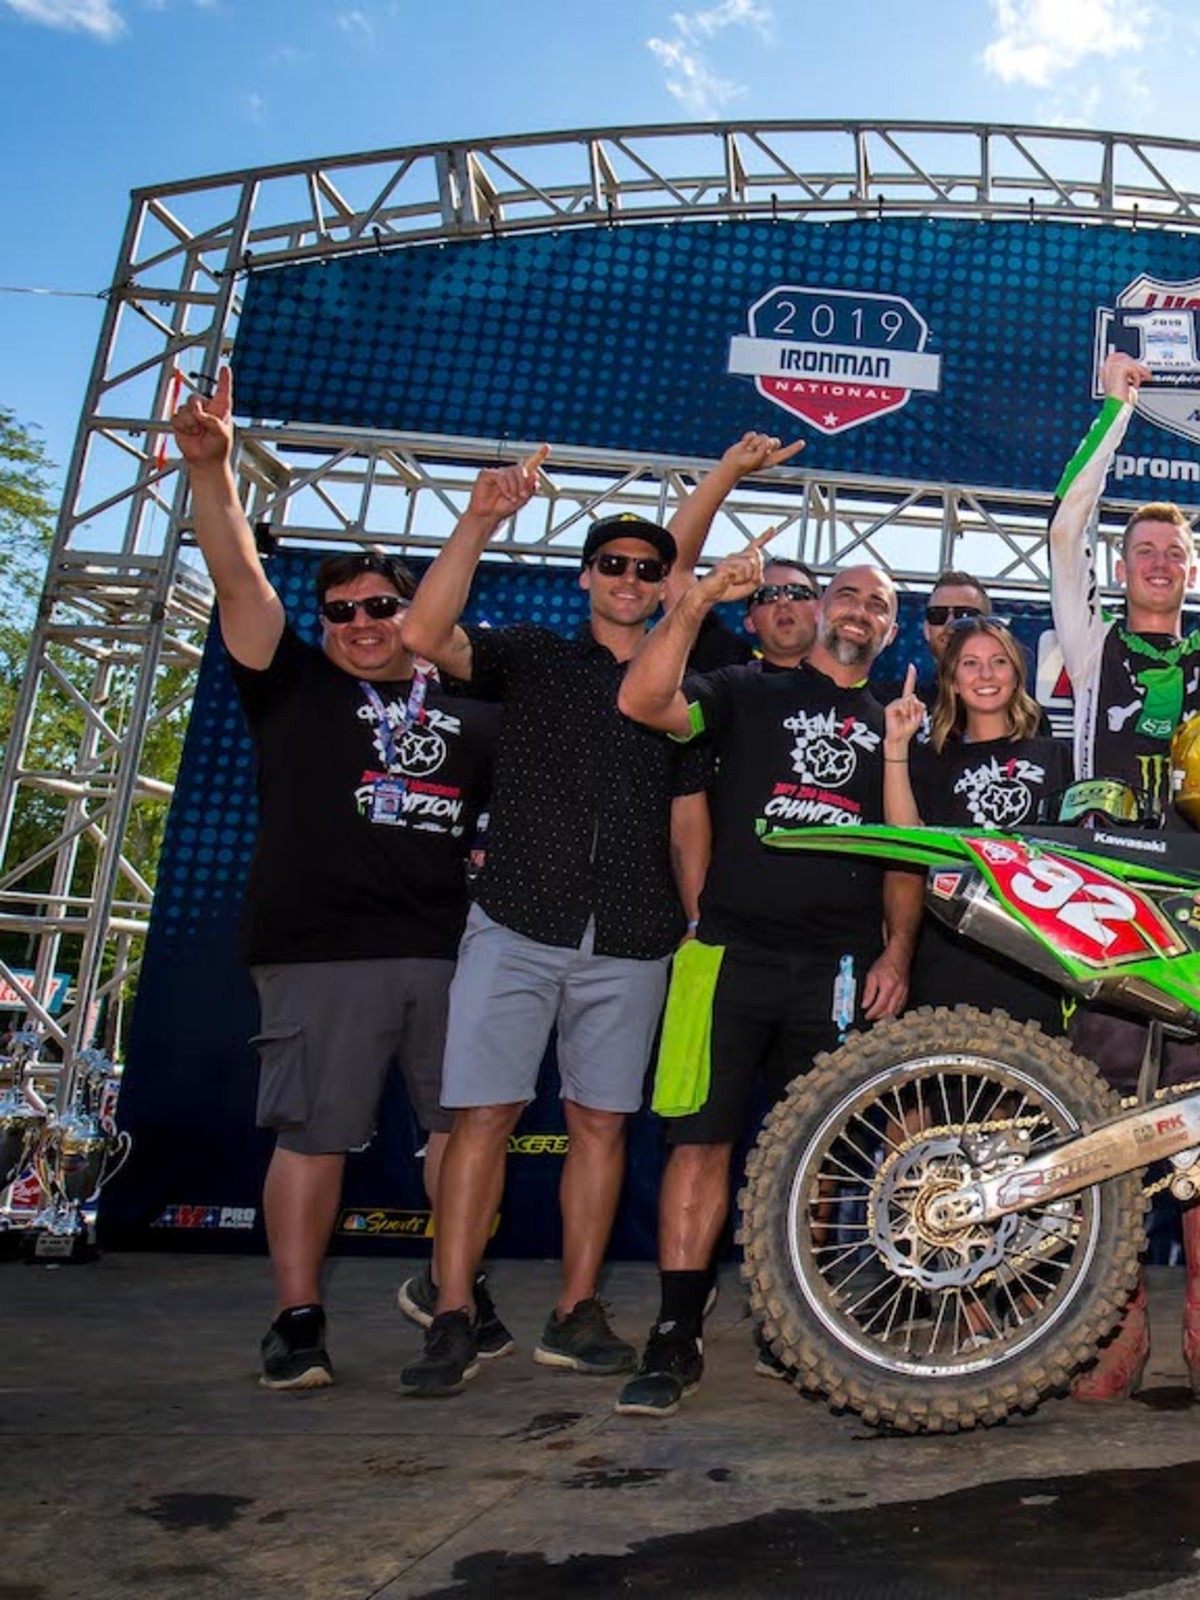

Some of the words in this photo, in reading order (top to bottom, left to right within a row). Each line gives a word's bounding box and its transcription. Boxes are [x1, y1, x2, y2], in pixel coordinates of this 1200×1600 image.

[773, 301, 902, 343] 2019
[780, 348, 891, 379] IRONMAN
[775, 381, 892, 401] NATIONAL
[1093, 831, 1167, 853] Kawasaki
[1010, 858, 1137, 948] 92
[1156, 1113, 1185, 1135] RK
[220, 1207, 257, 1222] PRO
[365, 1211, 424, 1233] Sports
